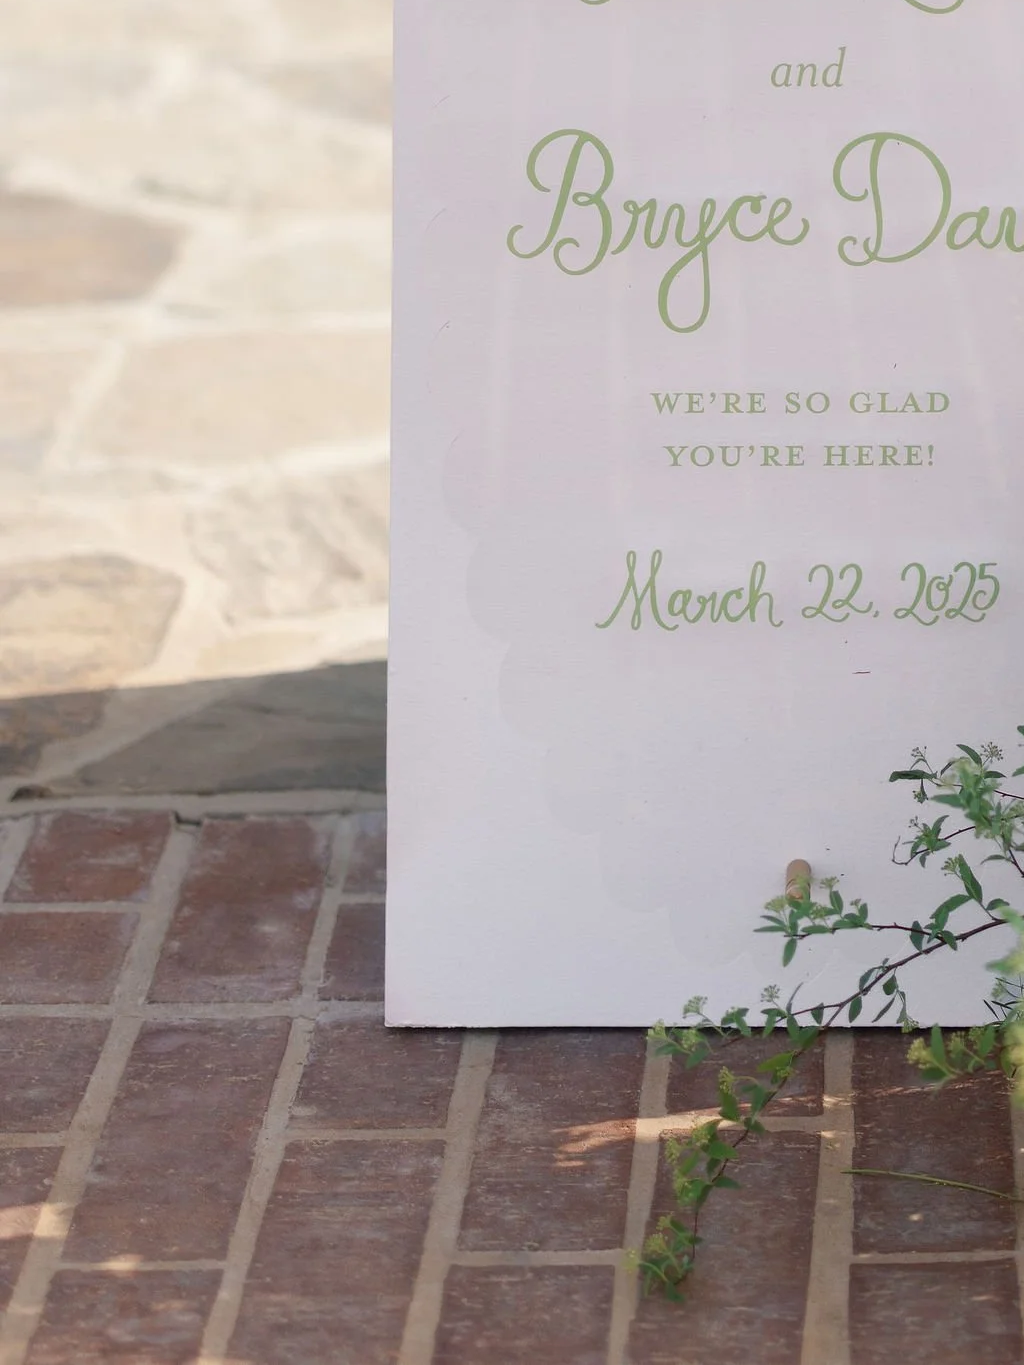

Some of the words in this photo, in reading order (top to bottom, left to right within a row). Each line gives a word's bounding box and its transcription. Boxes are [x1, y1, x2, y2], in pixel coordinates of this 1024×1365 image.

[770, 47, 847, 89] and
[506, 128, 811, 334] Bryce
[650, 391, 767, 415] WE'RE
[784, 391, 831, 415] SO
[848, 390, 951, 415] GLAD
[662, 442, 806, 469] YOU'RE
[822, 442, 936, 468] HERE!
[596, 548, 783, 630] March
[801, 562, 879, 622] 22,
[895, 560, 1001, 627] 2025
